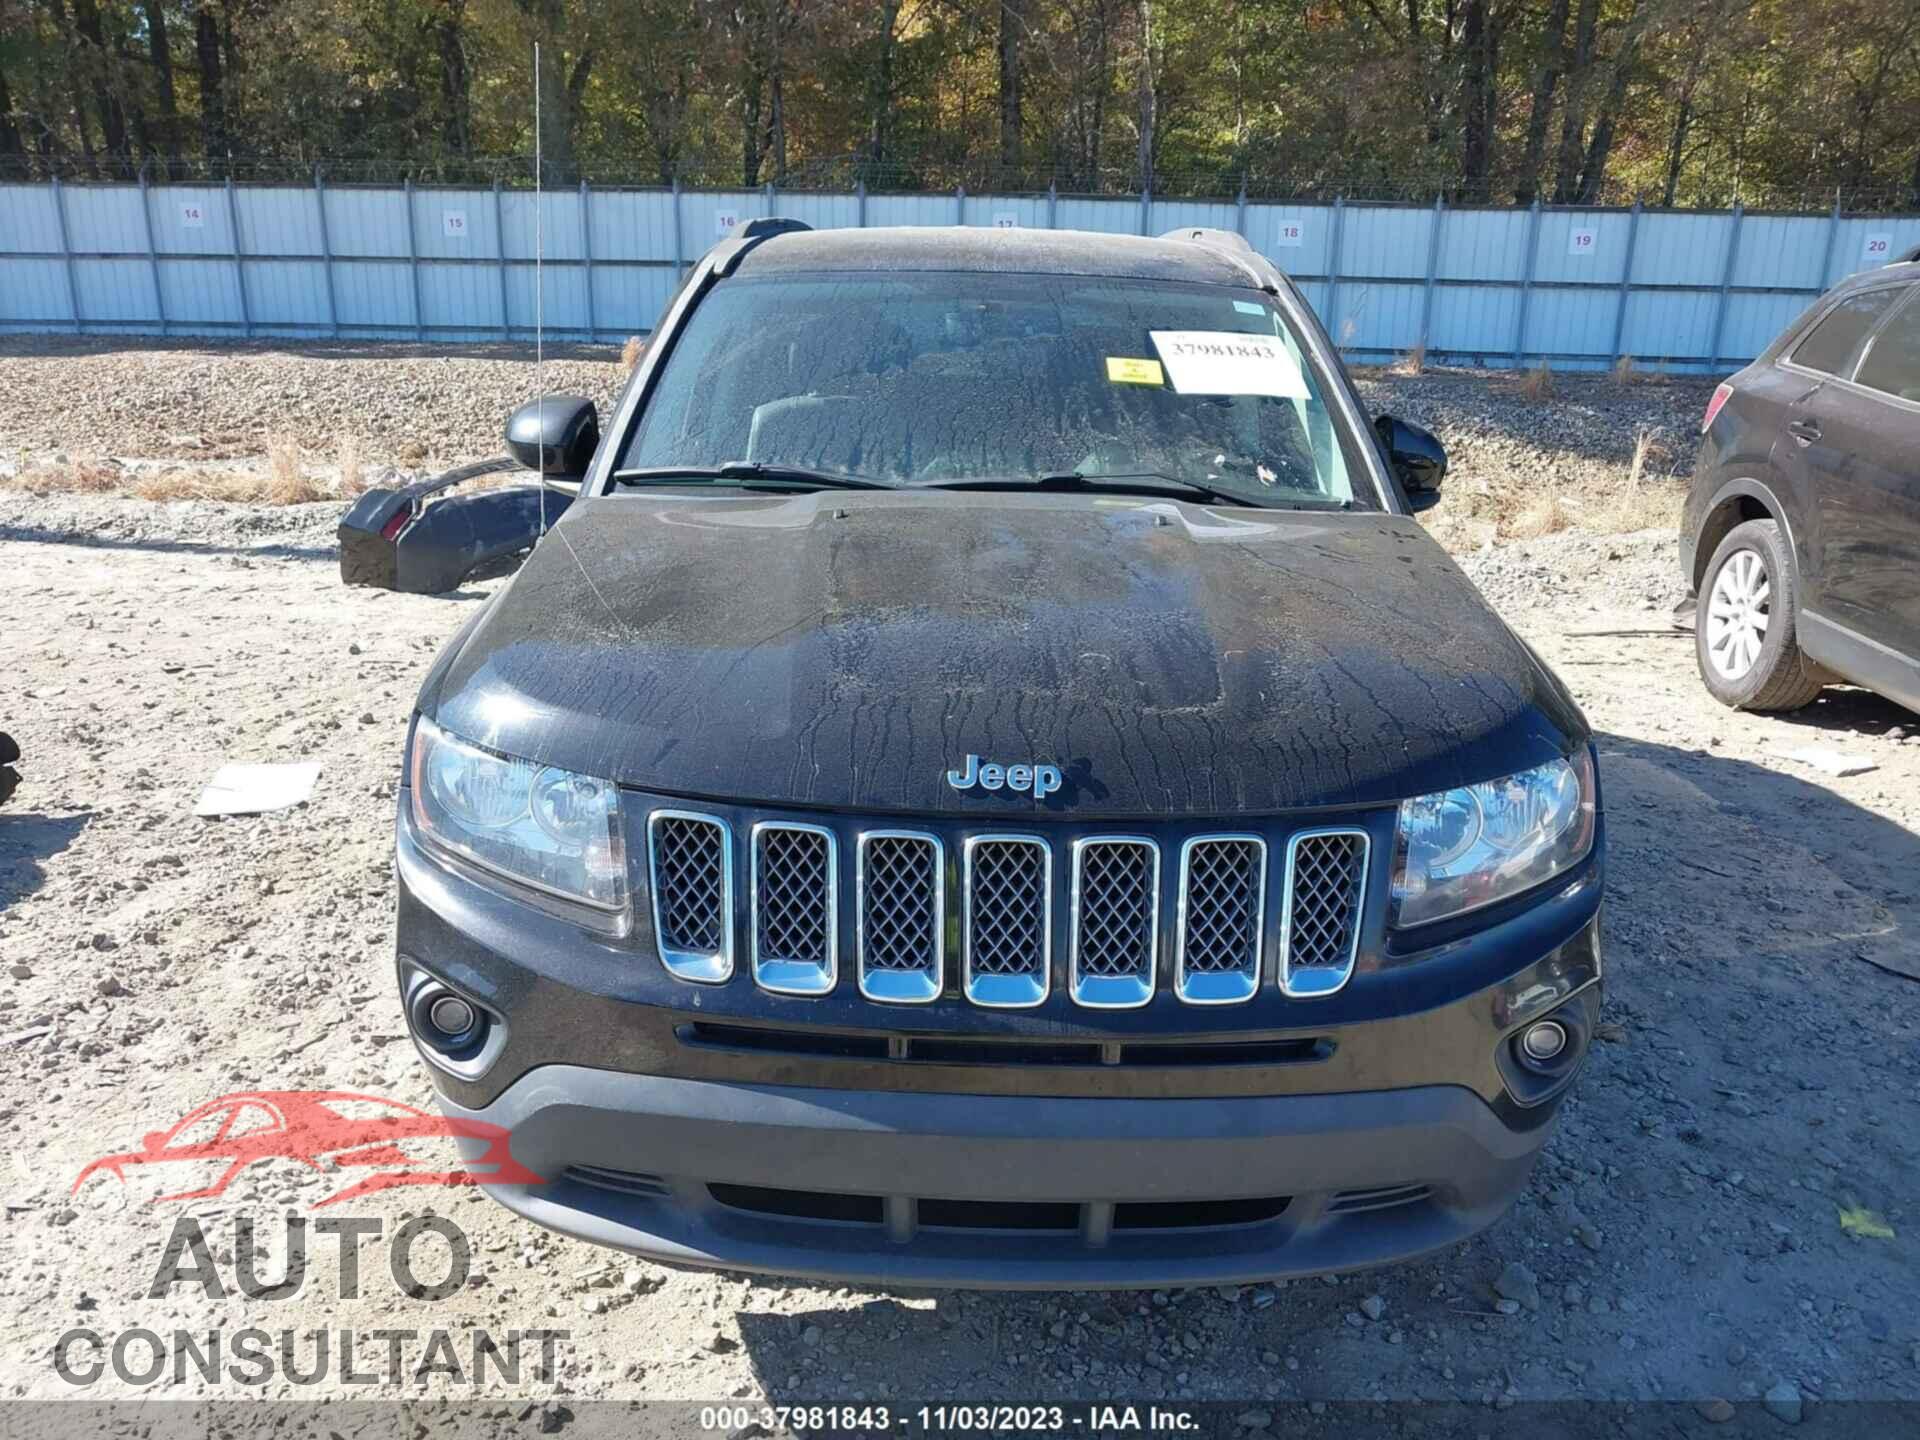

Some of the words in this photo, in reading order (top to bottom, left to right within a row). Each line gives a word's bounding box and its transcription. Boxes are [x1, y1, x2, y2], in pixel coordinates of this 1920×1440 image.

[185, 209, 200, 219] 14
[449, 218, 463, 228] 15
[720, 216, 735, 227] 16
[1284, 227, 1298, 238] 18
[1575, 235, 1591, 246] 19
[1869, 240, 1886, 251] 20
[1172, 343, 1276, 359] 37981843
[947, 754, 1062, 799] Jeep
